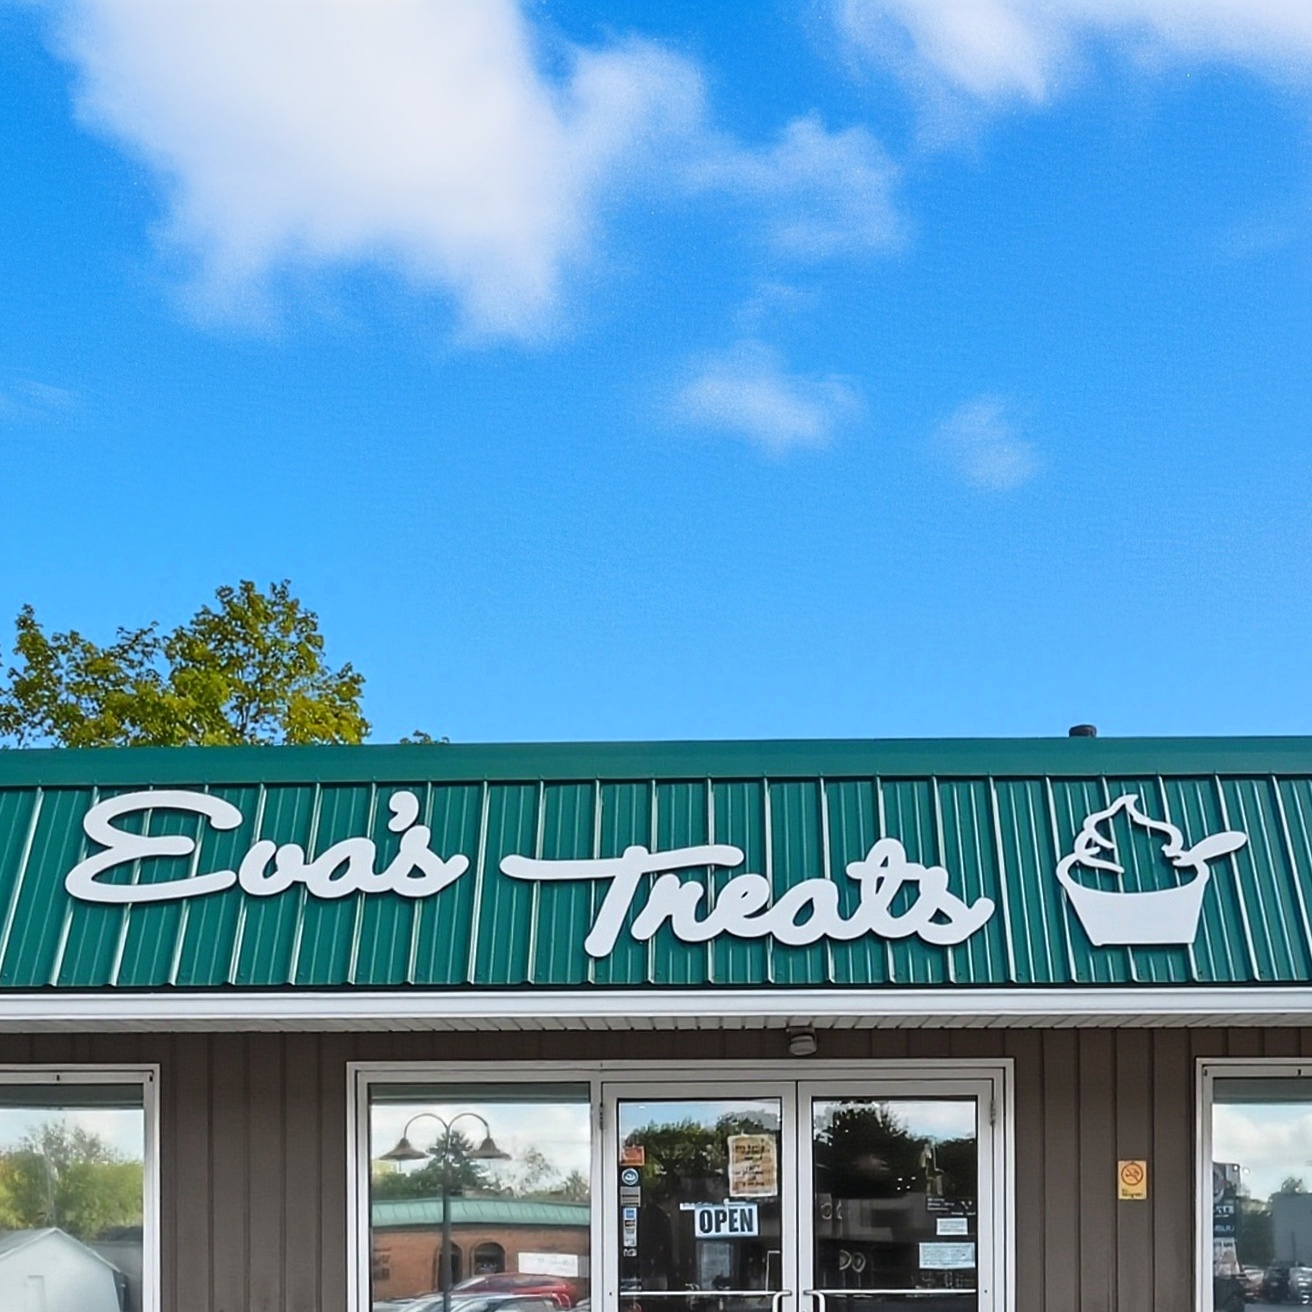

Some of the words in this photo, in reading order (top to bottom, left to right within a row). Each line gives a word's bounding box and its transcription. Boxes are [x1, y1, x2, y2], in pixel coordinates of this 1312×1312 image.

[65, 790, 469, 902] Eva's
[500, 838, 995, 957] Treats
[699, 1208, 754, 1234] OPEN
